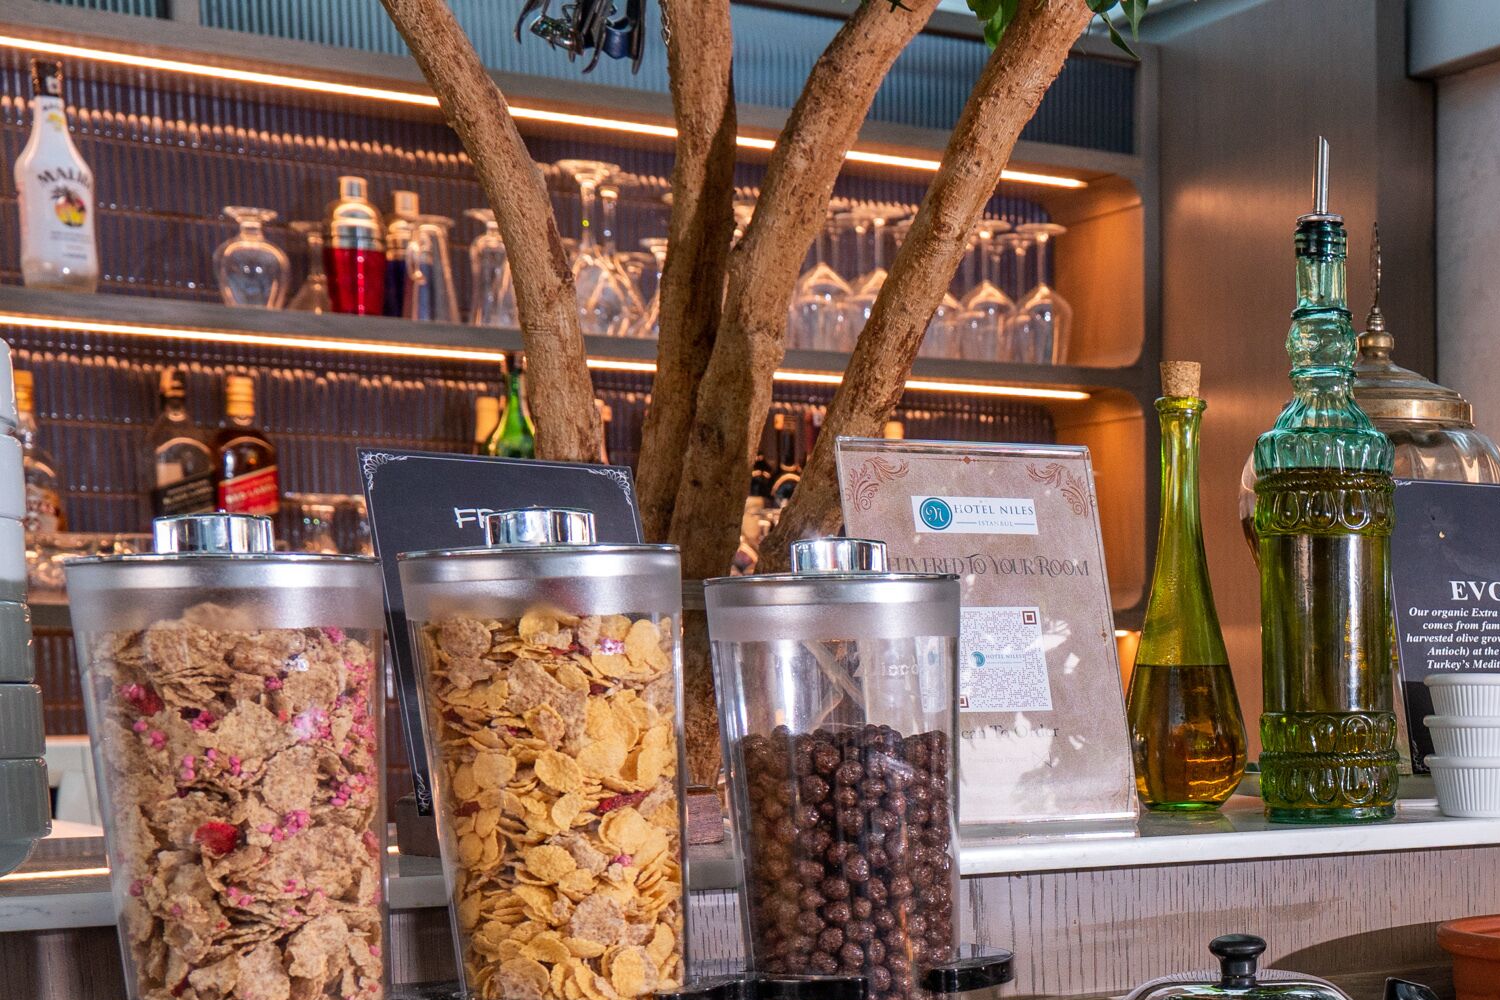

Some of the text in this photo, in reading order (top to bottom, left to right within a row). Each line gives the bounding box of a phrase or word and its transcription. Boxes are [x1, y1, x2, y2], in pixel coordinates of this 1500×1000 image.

[954, 504, 1034, 516] HOTEL NILES
[886, 553, 1089, 577] ELIVERED TO YOUR ROOM
[1408, 606, 1430, 617] Our
[1432, 607, 1469, 619] organic
[1471, 607, 1498, 617] Extra
[1422, 621, 1453, 630] comes
[1455, 621, 1479, 632] from
[1406, 633, 1454, 643] harvested
[1456, 634, 1479, 643] olive
[1427, 646, 1470, 657] Antioch)
[1472, 647, 1482, 656] at
[1484, 646, 1499, 656] the
